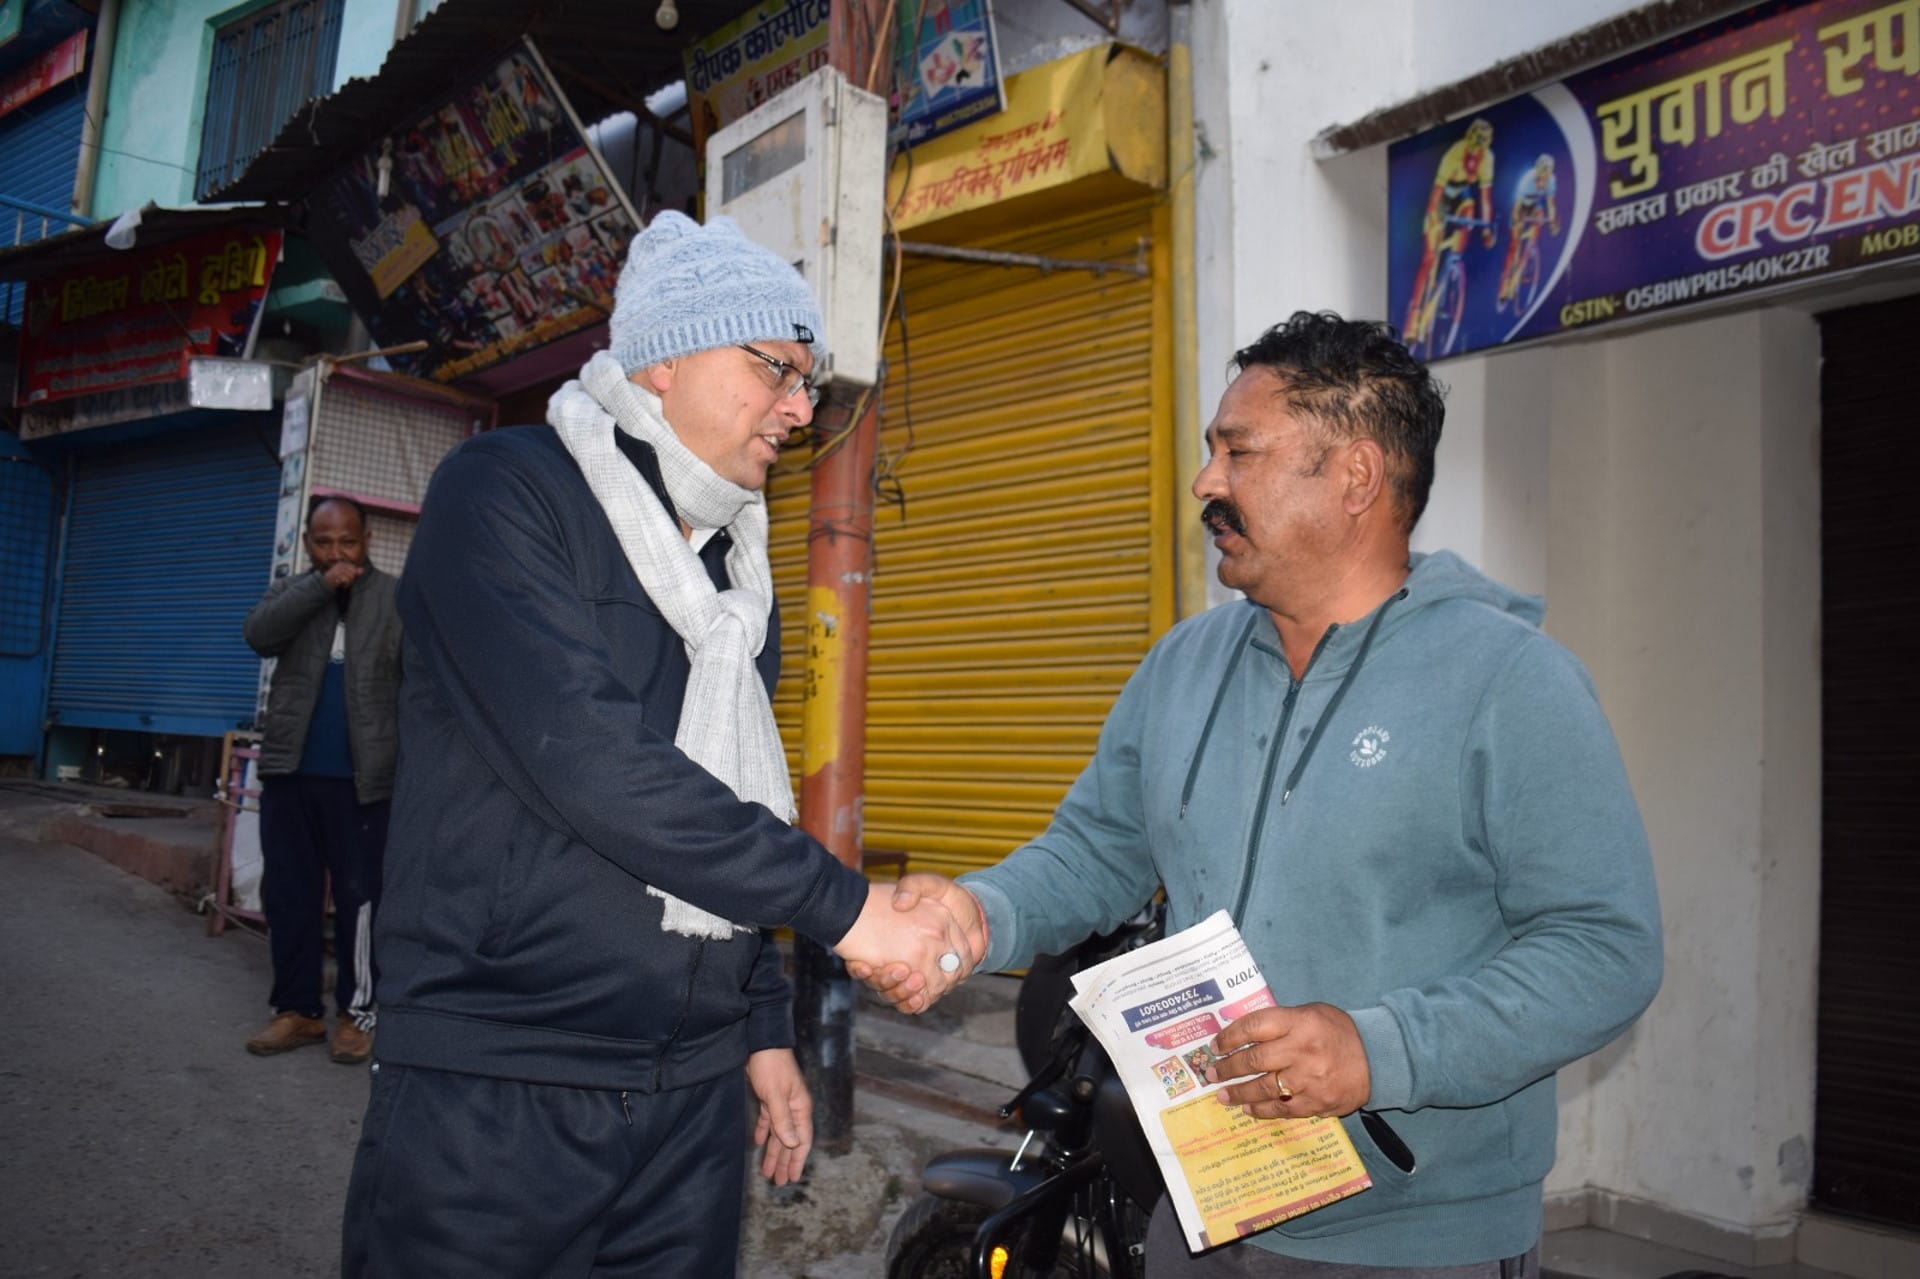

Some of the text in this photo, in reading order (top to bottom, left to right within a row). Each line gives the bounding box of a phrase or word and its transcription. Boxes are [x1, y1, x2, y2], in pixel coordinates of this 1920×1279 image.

[690, 39, 742, 92] दीपक
[1596, 39, 1793, 199] युवान
[1595, 193, 1667, 235] समस्त
[1675, 171, 1744, 217] प्रकार
[1751, 153, 1789, 189] की
[1798, 139, 1857, 177] खेल
[1698, 183, 1816, 258] CPC
[1138, 987, 1199, 1017] 7374003601
